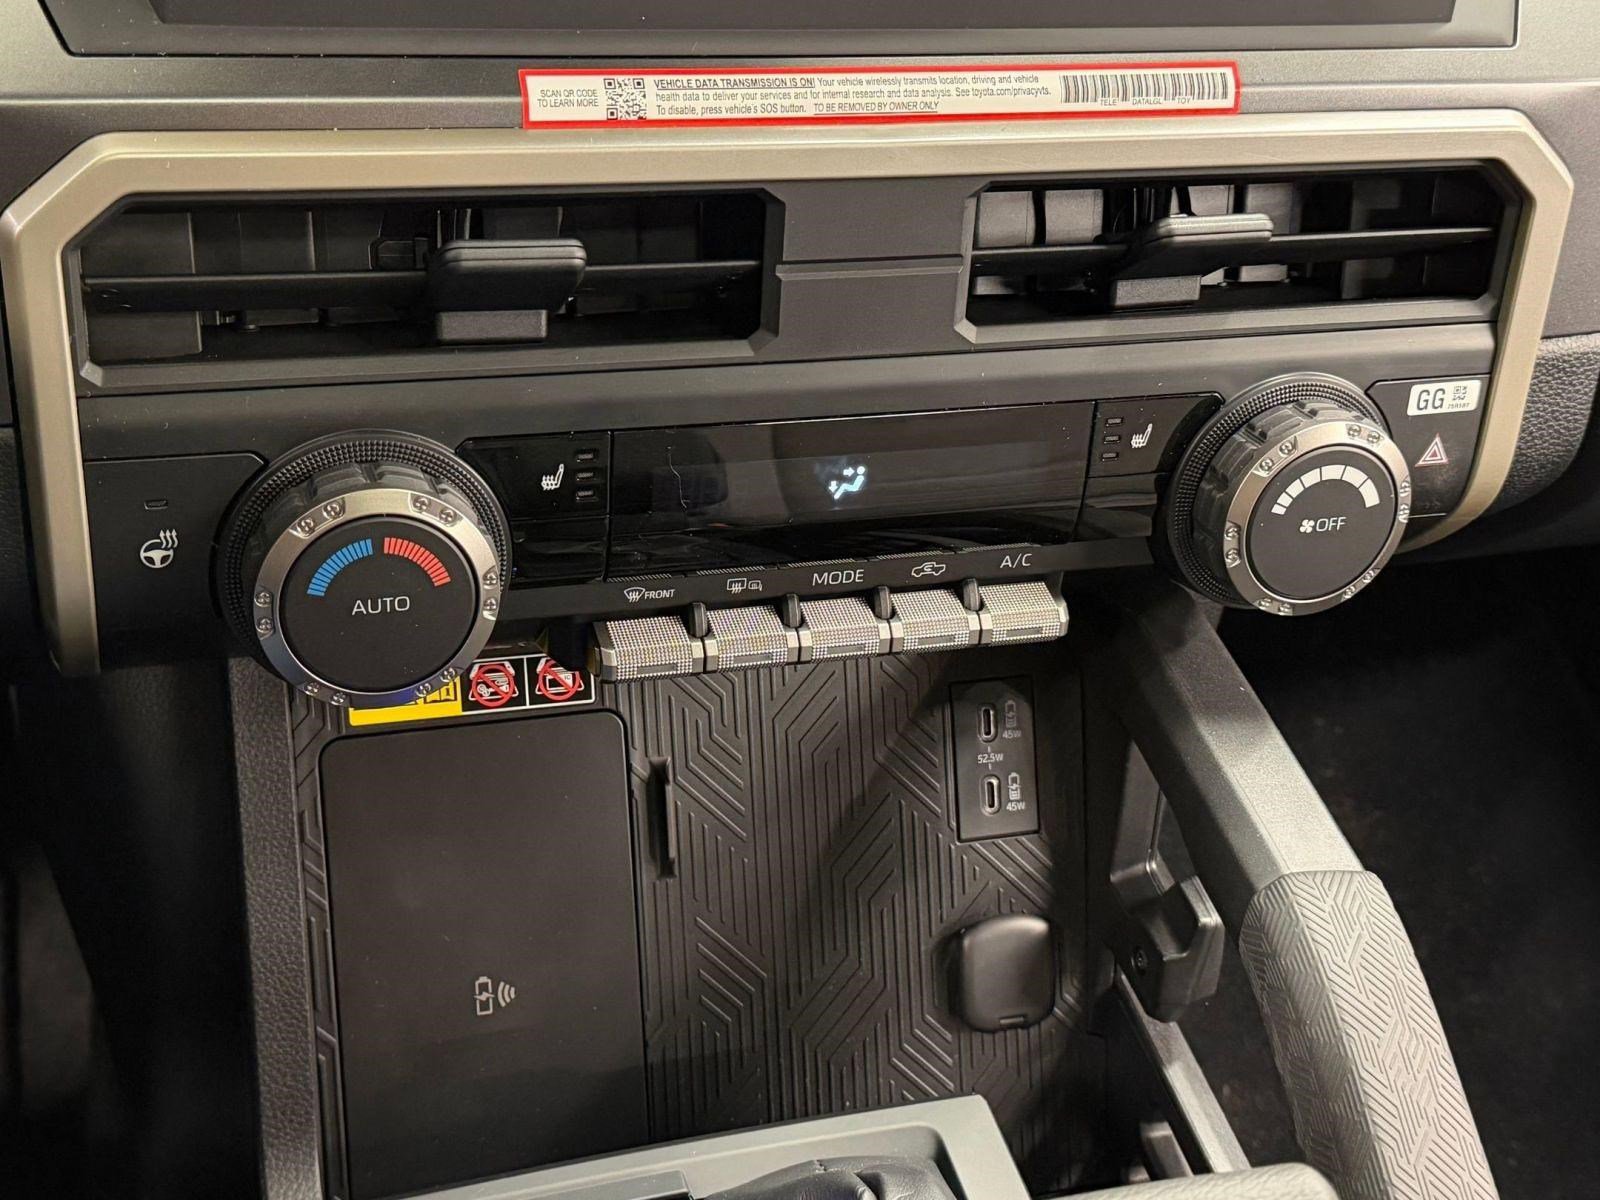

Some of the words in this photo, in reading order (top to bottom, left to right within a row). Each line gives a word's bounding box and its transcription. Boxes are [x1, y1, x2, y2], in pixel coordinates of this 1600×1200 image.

[654, 79, 694, 89] VEHICLE
[695, 79, 719, 89] DATA
[720, 78, 787, 88] TRANSMISSION
[789, 78, 798, 88] IS
[800, 77, 815, 87] ON!
[817, 77, 834, 87] Your
[837, 77, 863, 86] vehicle
[866, 76, 901, 87] wirelessly
[903, 76, 938, 85] transmits
[939, 75, 969, 86] location,
[972, 75, 996, 86] driving
[998, 75, 1012, 84] and
[1014, 74, 1039, 83] vehicle
[540, 90, 562, 98] SCAN
[563, 89, 575, 98] QR
[576, 89, 598, 98] CODE
[656, 91, 680, 102] health
[682, 91, 700, 101] data
[702, 91, 711, 101] to
[713, 91, 738, 100] deliver
[741, 92, 758, 103] your
[760, 90, 792, 100] services
[794, 90, 808, 99] and
[810, 90, 820, 99] for
[822, 89, 850, 99] internal
[852, 89, 884, 98] research
[887, 88, 901, 98] and
[903, 88, 919, 98] data
[921, 88, 953, 99] analysis.
[955, 87, 970, 97] See
[537, 99, 549, 108] TO
[550, 99, 574, 107] LEARN
[576, 98, 599, 107] MORE
[656, 105, 666, 115] To
[668, 105, 699, 116] disable,
[700, 106, 723, 117] press
[760, 103, 778, 114] SOS
[780, 103, 806, 113] button.
[814, 103, 824, 112] TO
[826, 102, 836, 112] BE
[838, 102, 876, 112] REMOVED
[877, 102, 888, 111] BY
[889, 101, 918, 110] OWNER
[919, 101, 940, 110] ONLY
[1416, 388, 1446, 411] GG
[1316, 516, 1347, 532] OFF
[1000, 553, 1033, 569] A/C
[812, 569, 864, 586] MODE
[644, 588, 675, 600] FRONT
[352, 596, 410, 616] AUTO
[1002, 730, 1022, 739] 45W
[977, 753, 1004, 764] 52.5W
[1006, 801, 1026, 811] 45W
